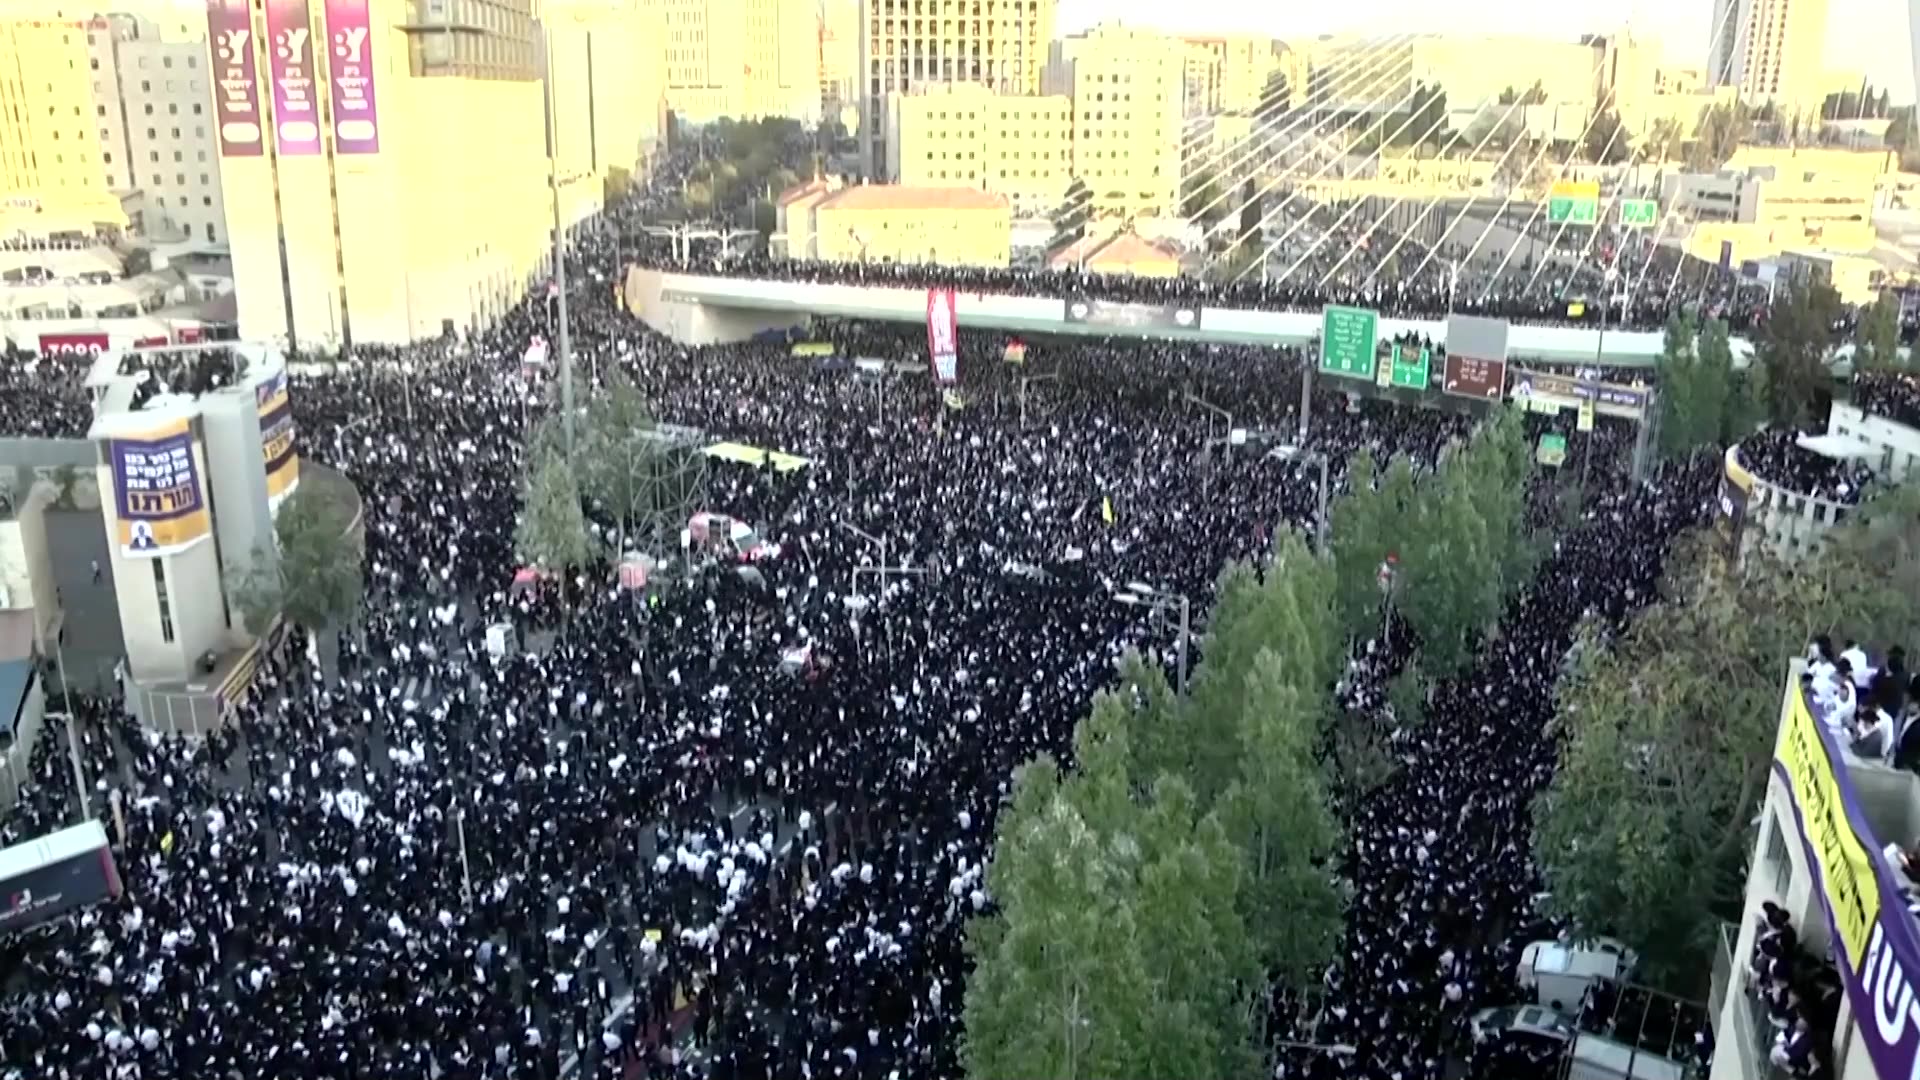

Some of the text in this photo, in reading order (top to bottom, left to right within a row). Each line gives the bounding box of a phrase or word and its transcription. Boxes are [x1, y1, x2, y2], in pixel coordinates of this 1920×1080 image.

[217, 29, 250, 64] BY
[276, 28, 309, 63] BY
[335, 27, 368, 62] BY
